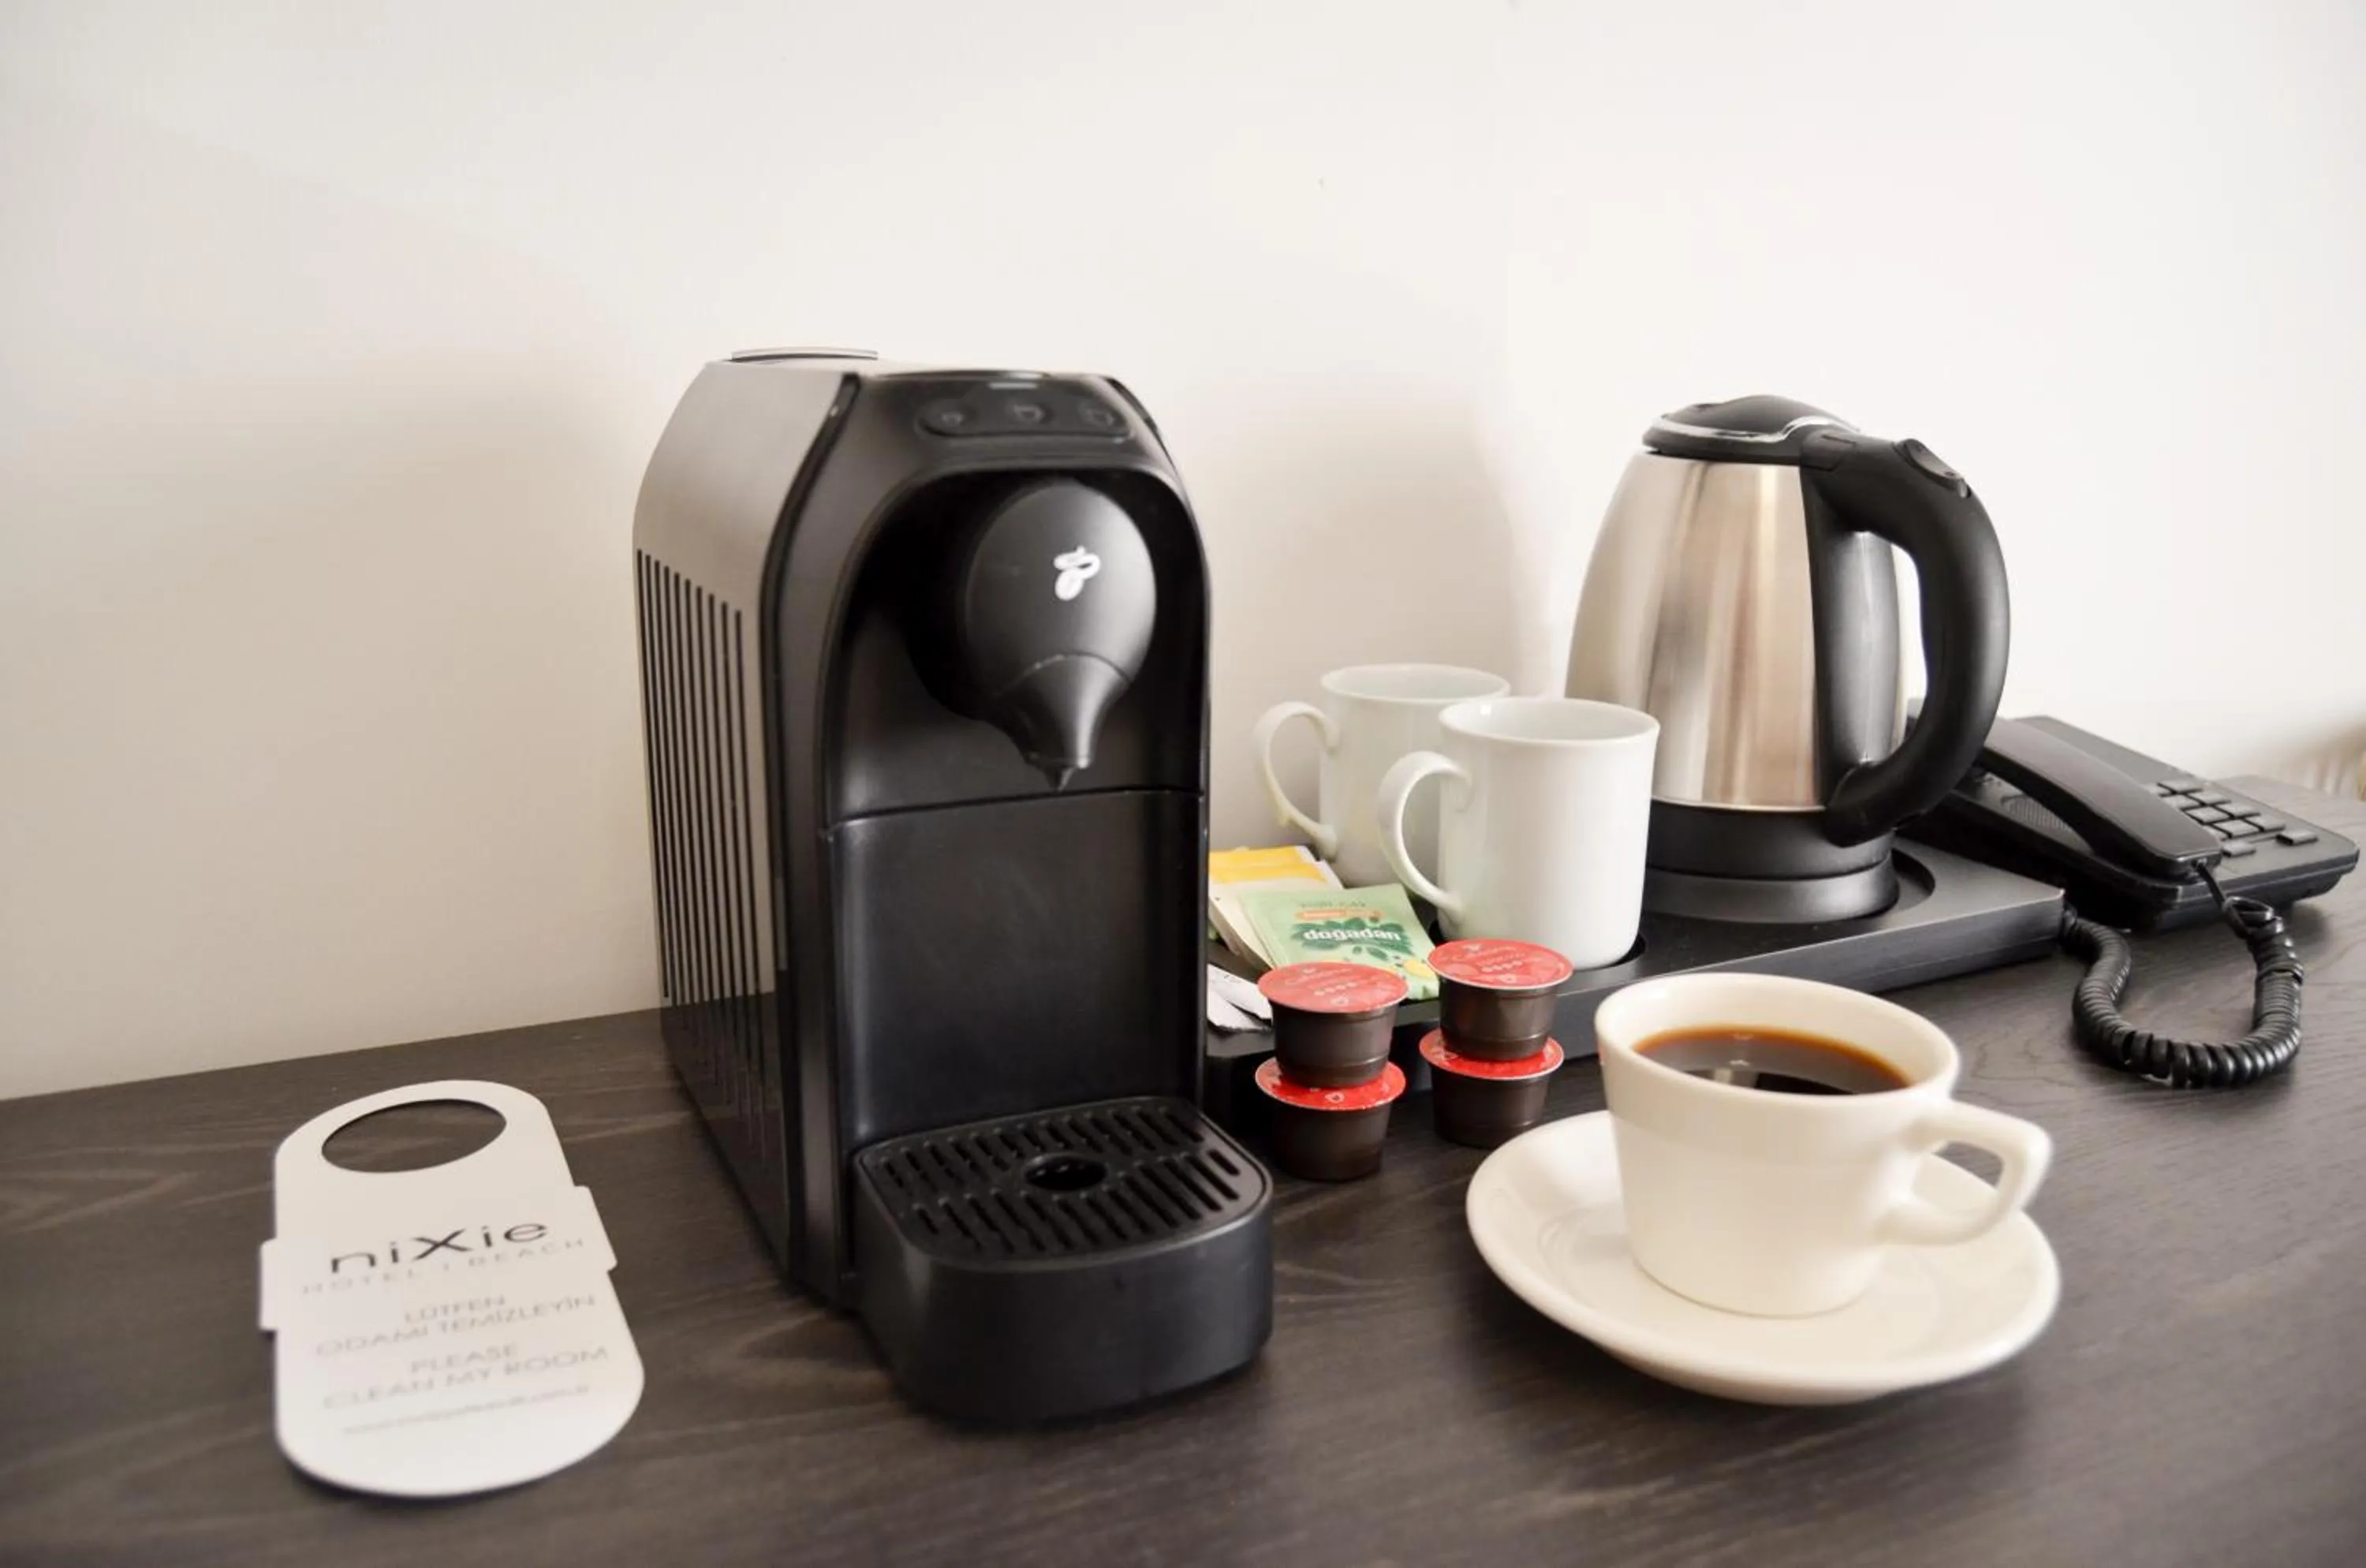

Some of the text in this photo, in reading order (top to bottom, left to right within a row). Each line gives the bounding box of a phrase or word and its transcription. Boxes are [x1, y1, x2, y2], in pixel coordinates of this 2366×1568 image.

[468, 1238, 584, 1267] BEACH
[410, 1342, 519, 1373] PLEASE
[323, 1376, 435, 1409] CLEAN
[445, 1367, 491, 1388] MY
[502, 1345, 609, 1376] ROOM
